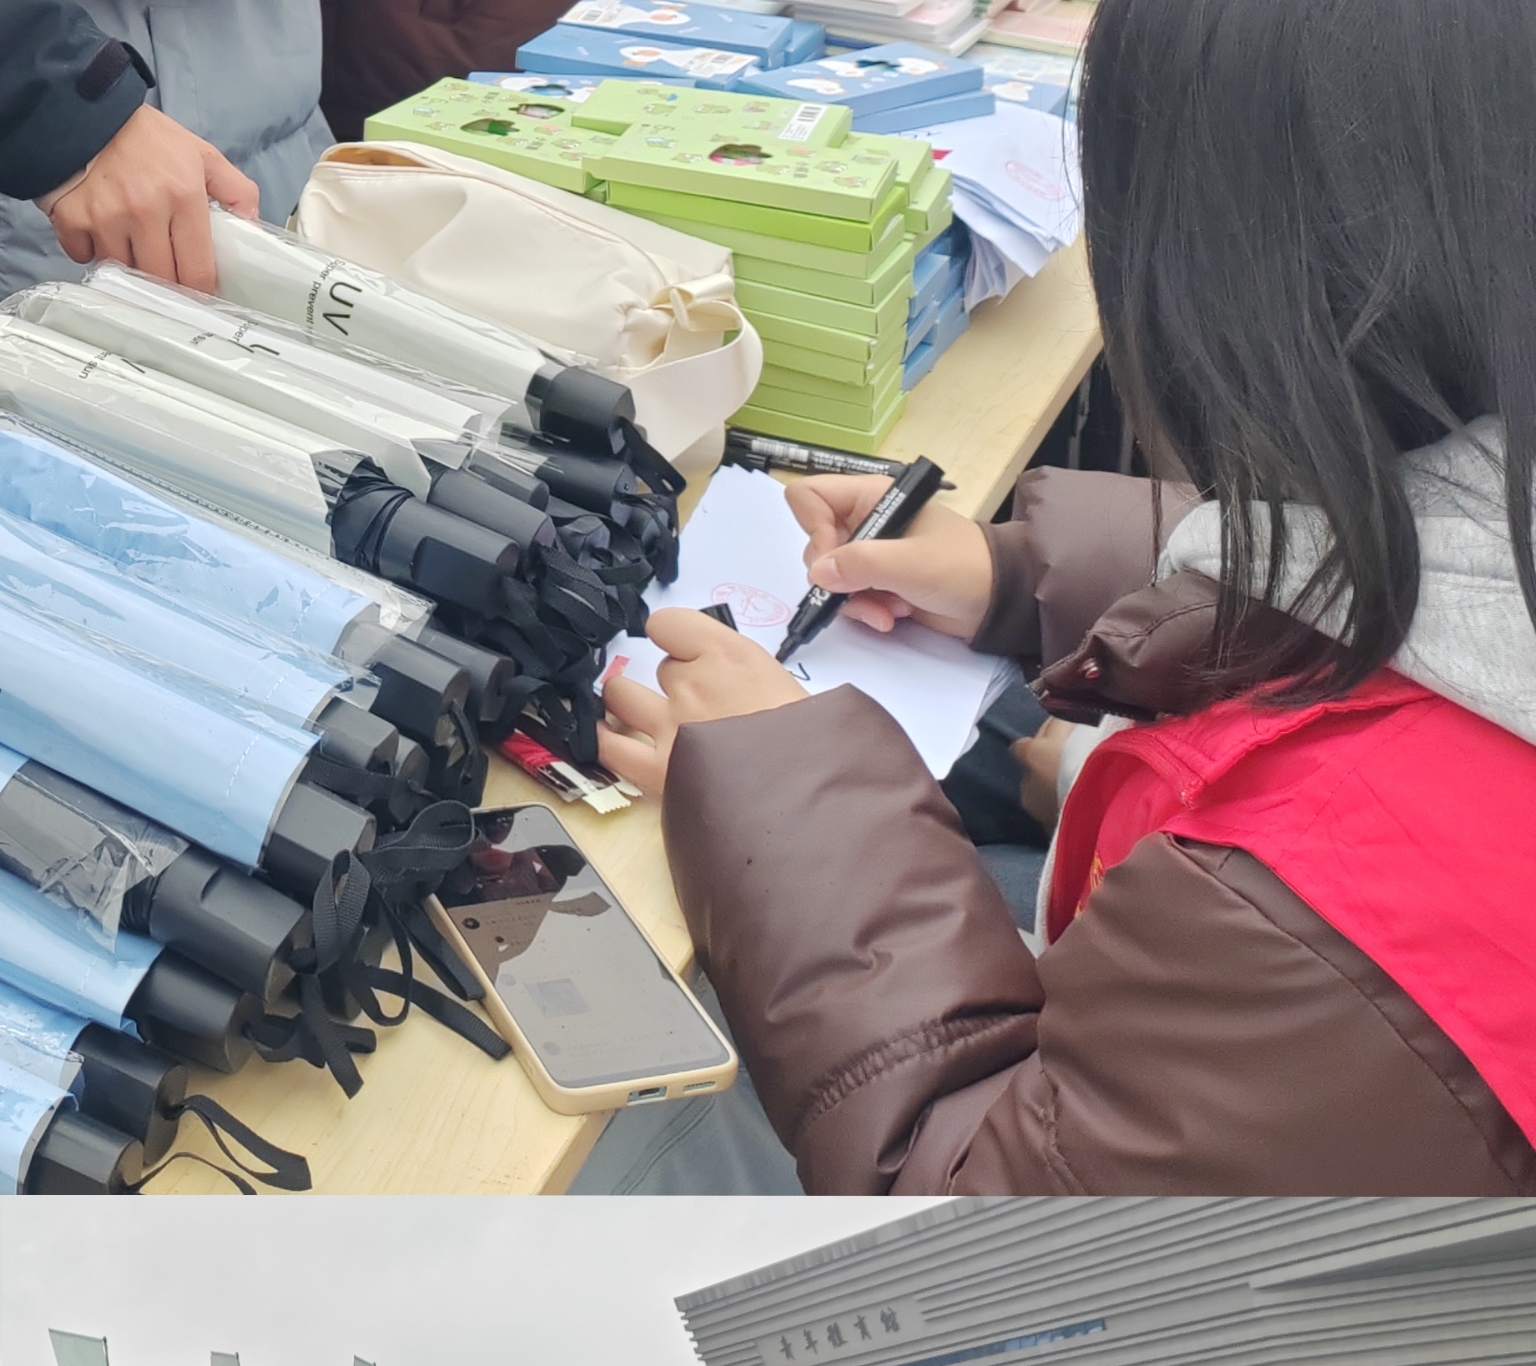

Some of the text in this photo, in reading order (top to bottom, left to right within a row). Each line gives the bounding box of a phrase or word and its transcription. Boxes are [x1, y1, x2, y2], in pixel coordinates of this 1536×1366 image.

[305, 258, 346, 325] Super prevent
[322, 281, 363, 336] UV
